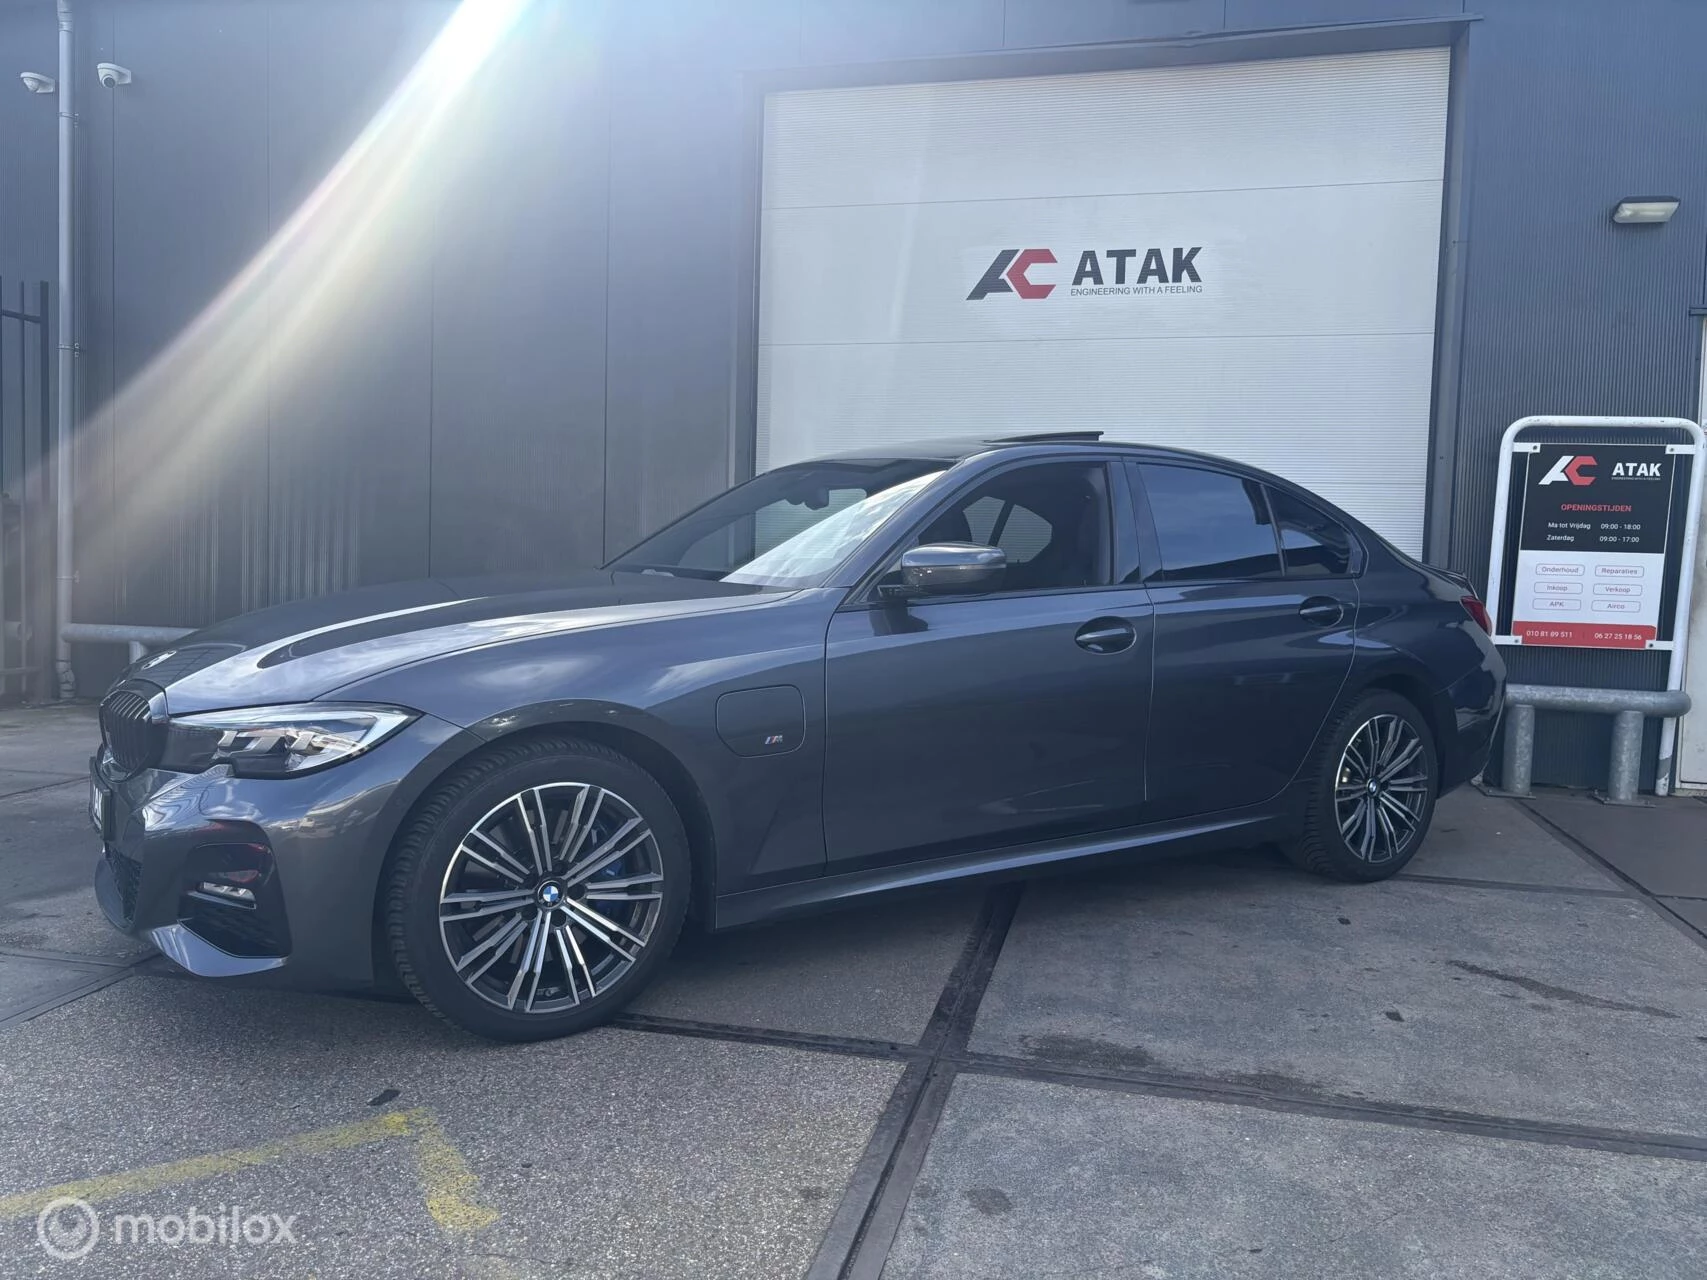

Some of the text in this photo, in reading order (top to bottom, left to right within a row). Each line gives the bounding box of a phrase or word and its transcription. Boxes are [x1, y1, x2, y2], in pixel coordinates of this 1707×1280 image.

[1071, 247, 1203, 286] ATAK
[1070, 285, 1203, 296] ENGINEERING WITH A FEELING
[1612, 462, 1662, 477] ATAK
[1560, 504, 1632, 512] OPENINGSTIJDEN
[1569, 522, 1591, 531] Vrijdag
[1546, 534, 1575, 542] Zaterdag
[1541, 566, 1579, 574] Onderhoud
[1601, 567, 1638, 576] Reparaties
[1546, 585, 1568, 593] Inkoop
[1605, 586, 1631, 594] Verkoop
